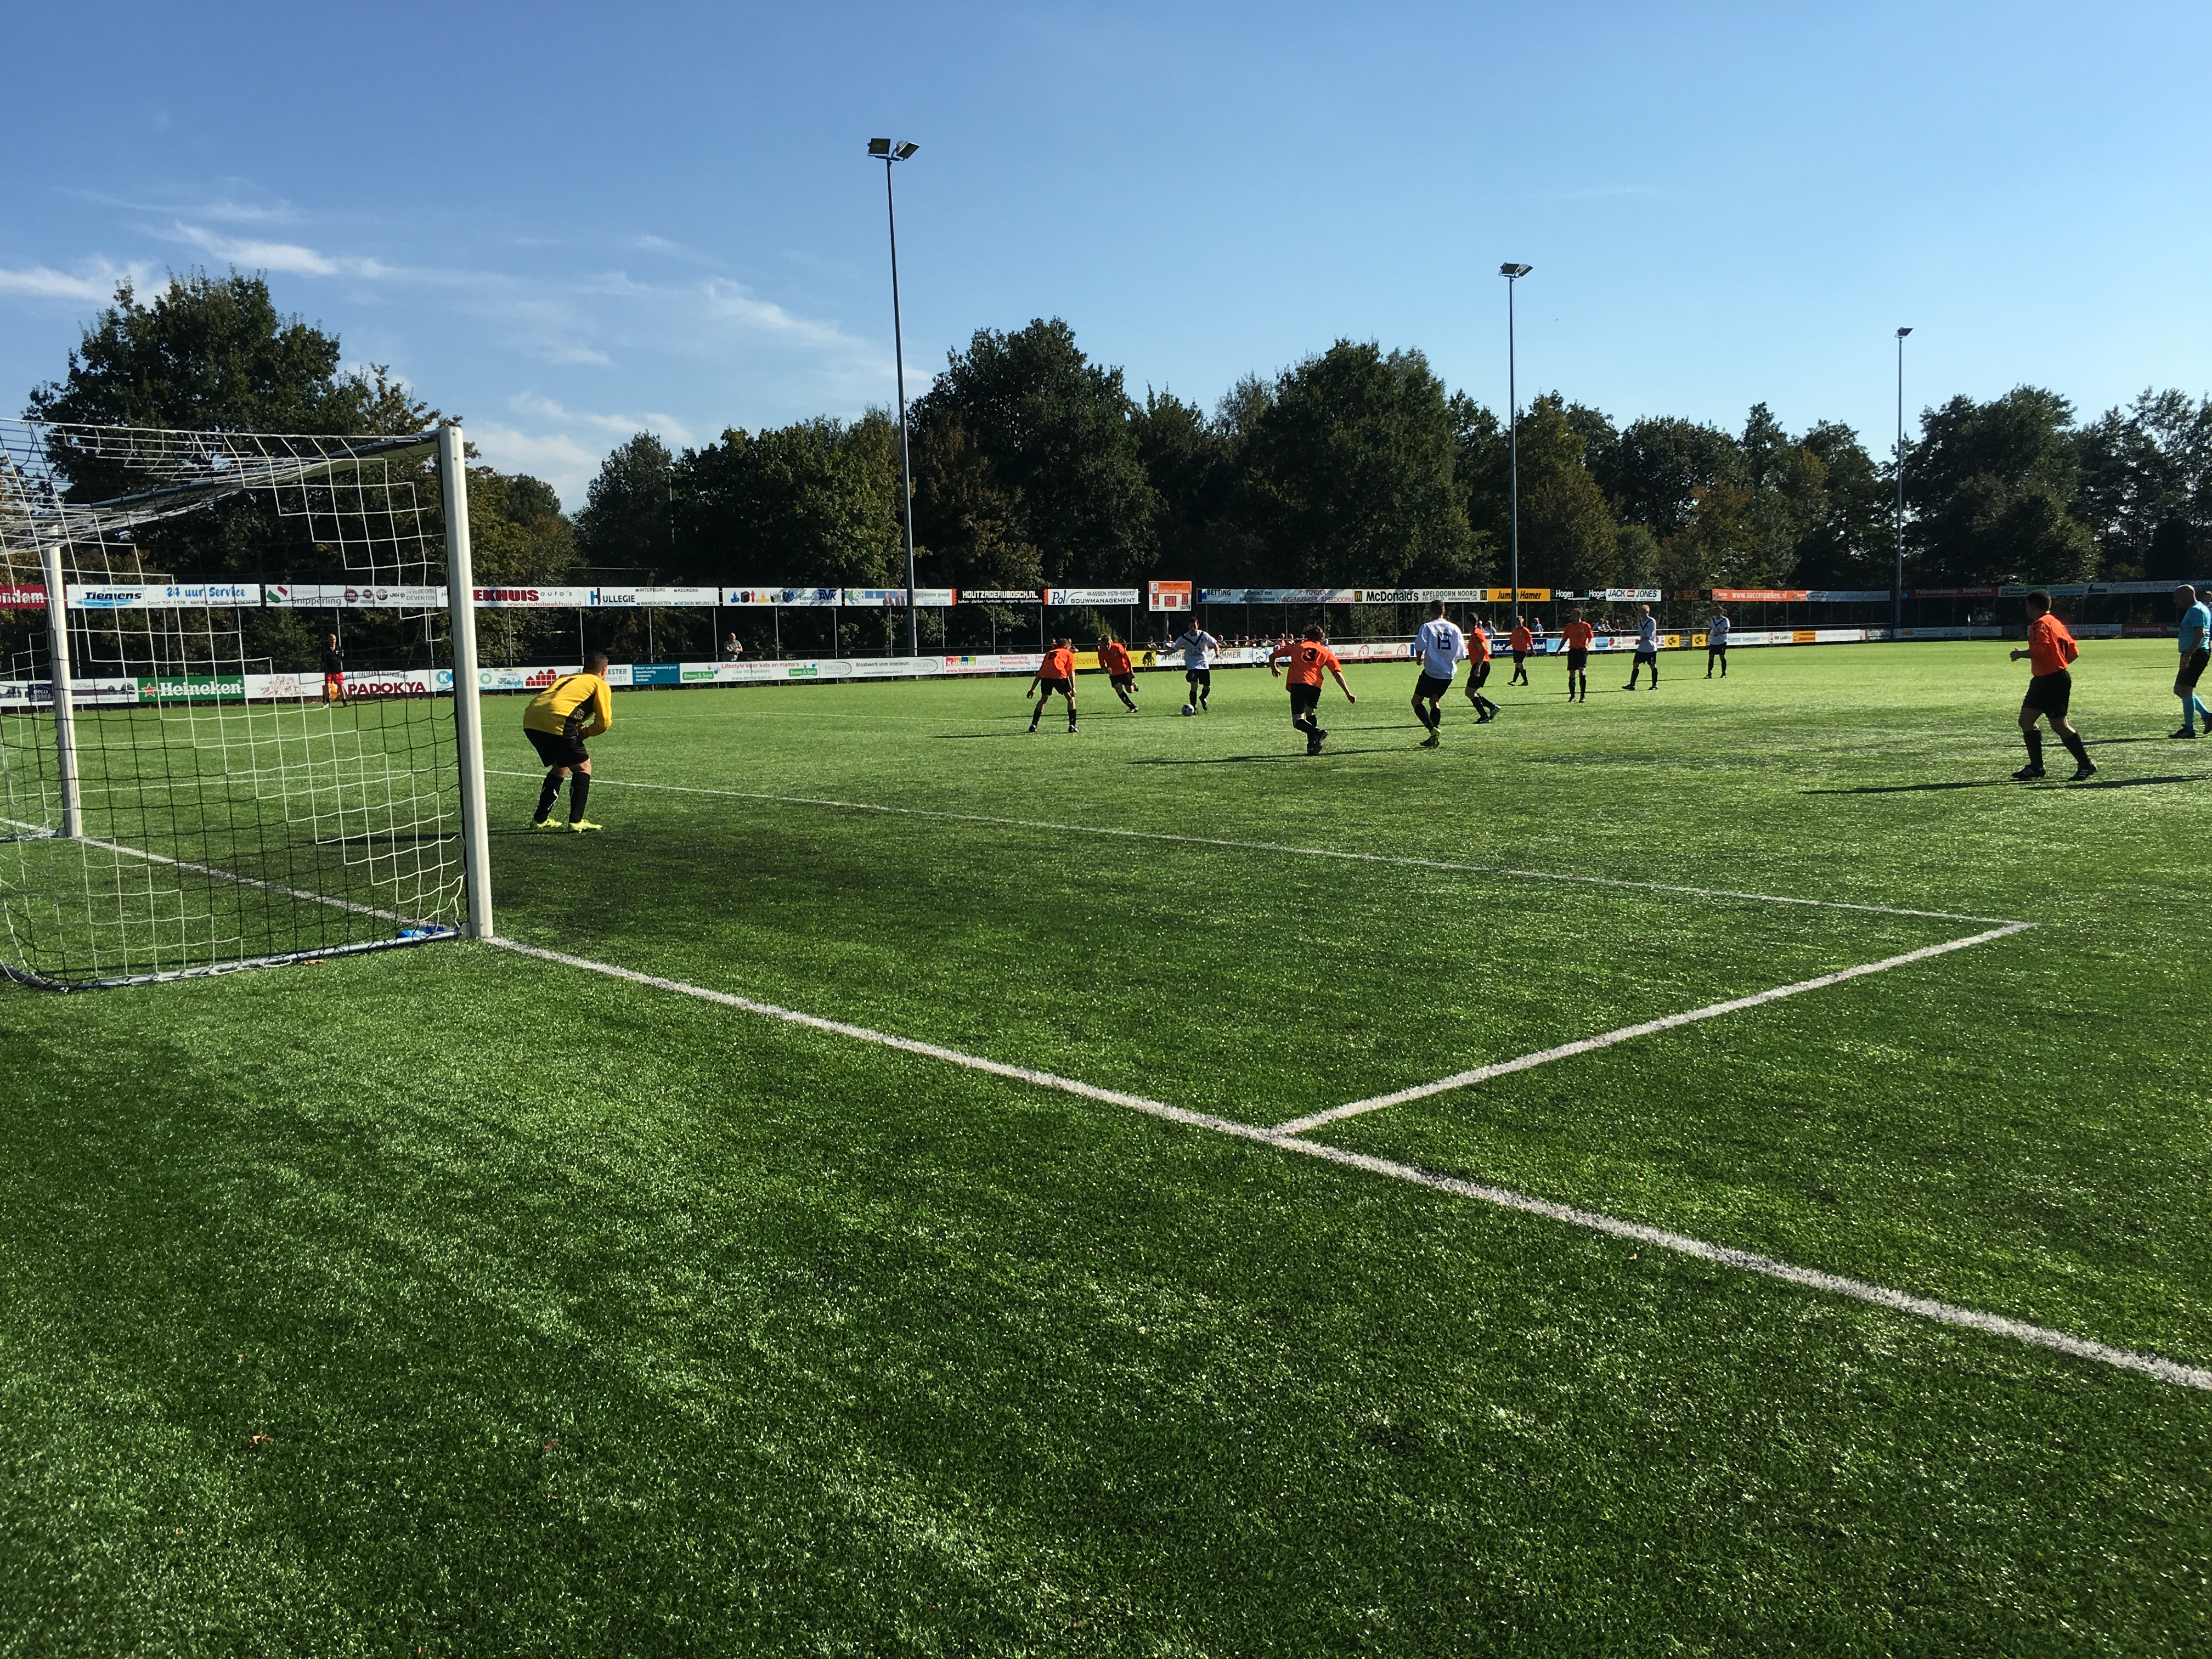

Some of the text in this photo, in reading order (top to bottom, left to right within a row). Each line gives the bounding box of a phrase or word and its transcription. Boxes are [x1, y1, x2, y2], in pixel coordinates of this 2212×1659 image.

[0, 589, 44, 603] ndam
[167, 586, 246, 598] 24 uur Service
[1051, 589, 1066, 605] Pol
[1365, 590, 1419, 602] McDonald's
[160, 681, 242, 696] Heineken
